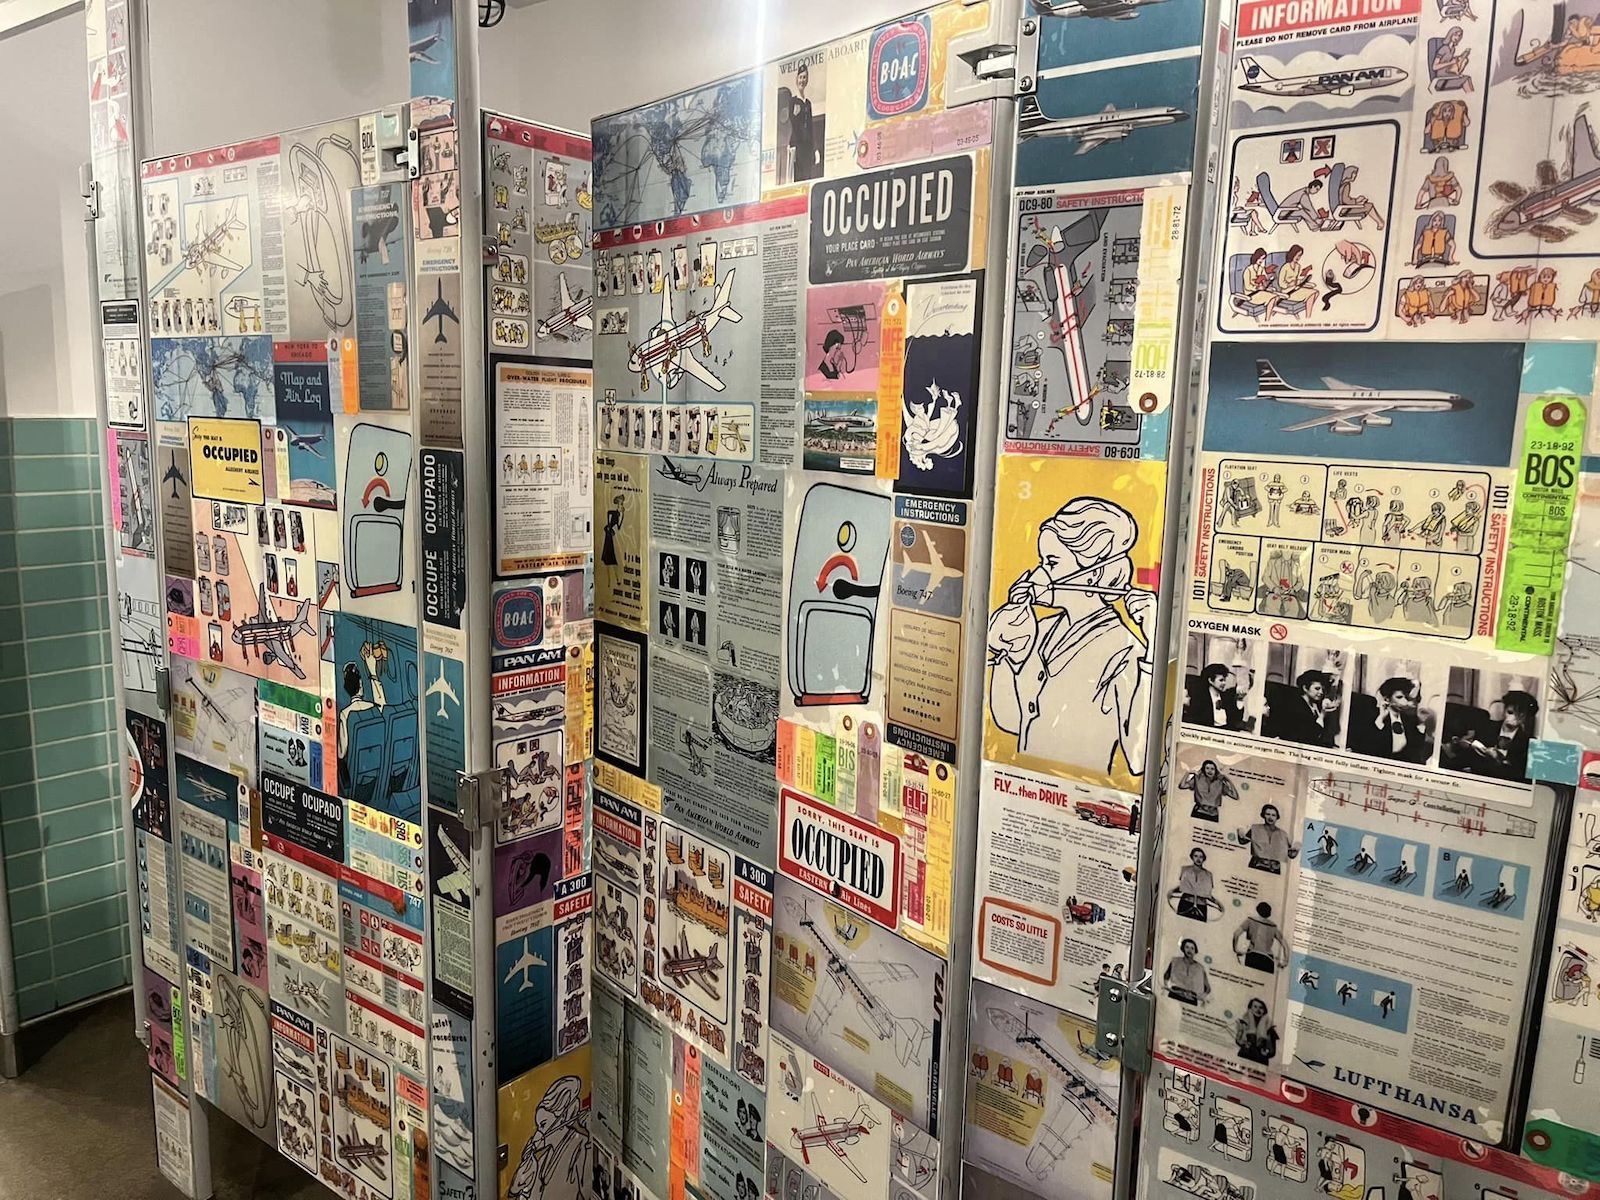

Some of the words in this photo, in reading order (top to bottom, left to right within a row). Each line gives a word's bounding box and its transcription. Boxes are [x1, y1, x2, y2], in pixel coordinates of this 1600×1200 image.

[1251, 0, 1402, 31] INFORMATION
[1236, 38, 1263, 47] PLEASE
[1266, 36, 1276, 44] DO
[1278, 34, 1294, 42] NOT
[1296, 29, 1328, 39] REMOVE
[1330, 25, 1350, 34] CARD
[1354, 22, 1376, 31] FROM
[1378, 16, 1418, 27] AIRPLANE
[779, 51, 824, 76] WELCOME
[828, 38, 868, 62] ABOARD
[362, 130, 374, 149] BDL
[358, 203, 394, 214] EMERGENCY
[822, 169, 954, 238] OCCUPIED
[1019, 197, 1053, 212] DC9-80
[1056, 198, 1088, 209] SAFETY
[825, 243, 840, 254] YOUR
[840, 240, 858, 252] PLACE
[860, 239, 876, 250] CARD
[420, 265, 458, 273] INSTRUCTIONS
[422, 258, 456, 266] EMERGENCY
[860, 256, 889, 267] AMERICAN
[892, 252, 914, 263] WORLD
[916, 249, 946, 260] AIRWAYS
[1136, 344, 1168, 369] HOU
[280, 372, 304, 390] Map
[306, 372, 322, 386] and
[284, 389, 302, 403] Air
[304, 390, 322, 411] Log
[203, 445, 258, 464] OCCUPIED
[1004, 440, 1066, 450] INSTRUCTIONS
[1068, 442, 1100, 454] SAFETY
[1104, 446, 1140, 459] DC9-80
[698, 461, 737, 492] Always
[738, 464, 778, 496] Prepared
[1524, 453, 1575, 488] BOS
[1018, 480, 1032, 500] 3
[1492, 485, 1509, 510] 1011
[900, 507, 960, 523] INSTRUCTIONS
[905, 499, 956, 512] EMERGENCY
[1202, 468, 1216, 542] INSTRUCTIONS
[1548, 506, 1566, 516] BOS
[1488, 513, 1501, 556] SAFETY
[517, 562, 544, 570] EASTERN
[1199, 542, 1210, 578] SAFETY
[896, 584, 918, 600] Boeing
[919, 589, 932, 600] 747
[1477, 556, 1496, 637] INSTRUCTIONS
[545, 602, 562, 617] BTV
[1520, 596, 1532, 642] CONTINENTAL
[1188, 619, 1228, 634] OXYGEN
[1231, 624, 1261, 637] MASK
[504, 653, 535, 668] PAN
[537, 650, 562, 662] AM
[498, 668, 560, 690] INFORMATION
[300, 716, 309, 735] BWI
[892, 726, 950, 752] INSTRUCTIONS
[1180, 732, 1199, 740] Quickly
[1200, 734, 1210, 742] pull
[838, 746, 856, 771] BIS
[896, 738, 945, 760] EMERGENCY
[264, 778, 296, 803] OCCUPÉ
[302, 792, 341, 822] OCUPADO
[600, 796, 621, 817] PAN
[620, 808, 638, 822] AM
[906, 788, 927, 812] ELP
[1039, 788, 1068, 808] DRIVE
[932, 796, 951, 824] BIL
[396, 820, 406, 841] SRQ
[596, 812, 637, 843] INFORMATION
[674, 802, 684, 814] PAN
[686, 808, 713, 826] AMERICAN
[714, 821, 734, 837] WORLD
[735, 831, 760, 849] AIRWAYS
[797, 805, 825, 826] SORRY,
[828, 818, 846, 834] THIS
[850, 826, 868, 843] SEAT
[872, 838, 880, 848] IS
[1307, 822, 1315, 830] A
[792, 818, 885, 900] OCCUPIED
[1443, 852, 1451, 861] B
[398, 870, 408, 890] TUS
[561, 884, 567, 896] A
[570, 876, 586, 892] 300
[741, 866, 748, 877] A
[750, 868, 766, 886] 300
[408, 895, 422, 908] 747
[738, 886, 770, 914] SAFETY
[798, 868, 828, 891] EASTERN
[840, 888, 851, 901] Air
[853, 894, 872, 914] Lines
[559, 893, 591, 915] SAFETY
[991, 913, 1014, 930] COSTS
[1016, 920, 1026, 932] SO
[1026, 924, 1048, 939] LITTLE
[276, 1006, 294, 1025] PAN
[293, 1015, 310, 1030] AM
[274, 1021, 313, 1052] INFORMATION
[705, 1062, 741, 1092] RESERVATIONS
[1334, 1065, 1477, 1125] LUFTHANSA
[704, 1132, 738, 1164] RESERVATIONS
